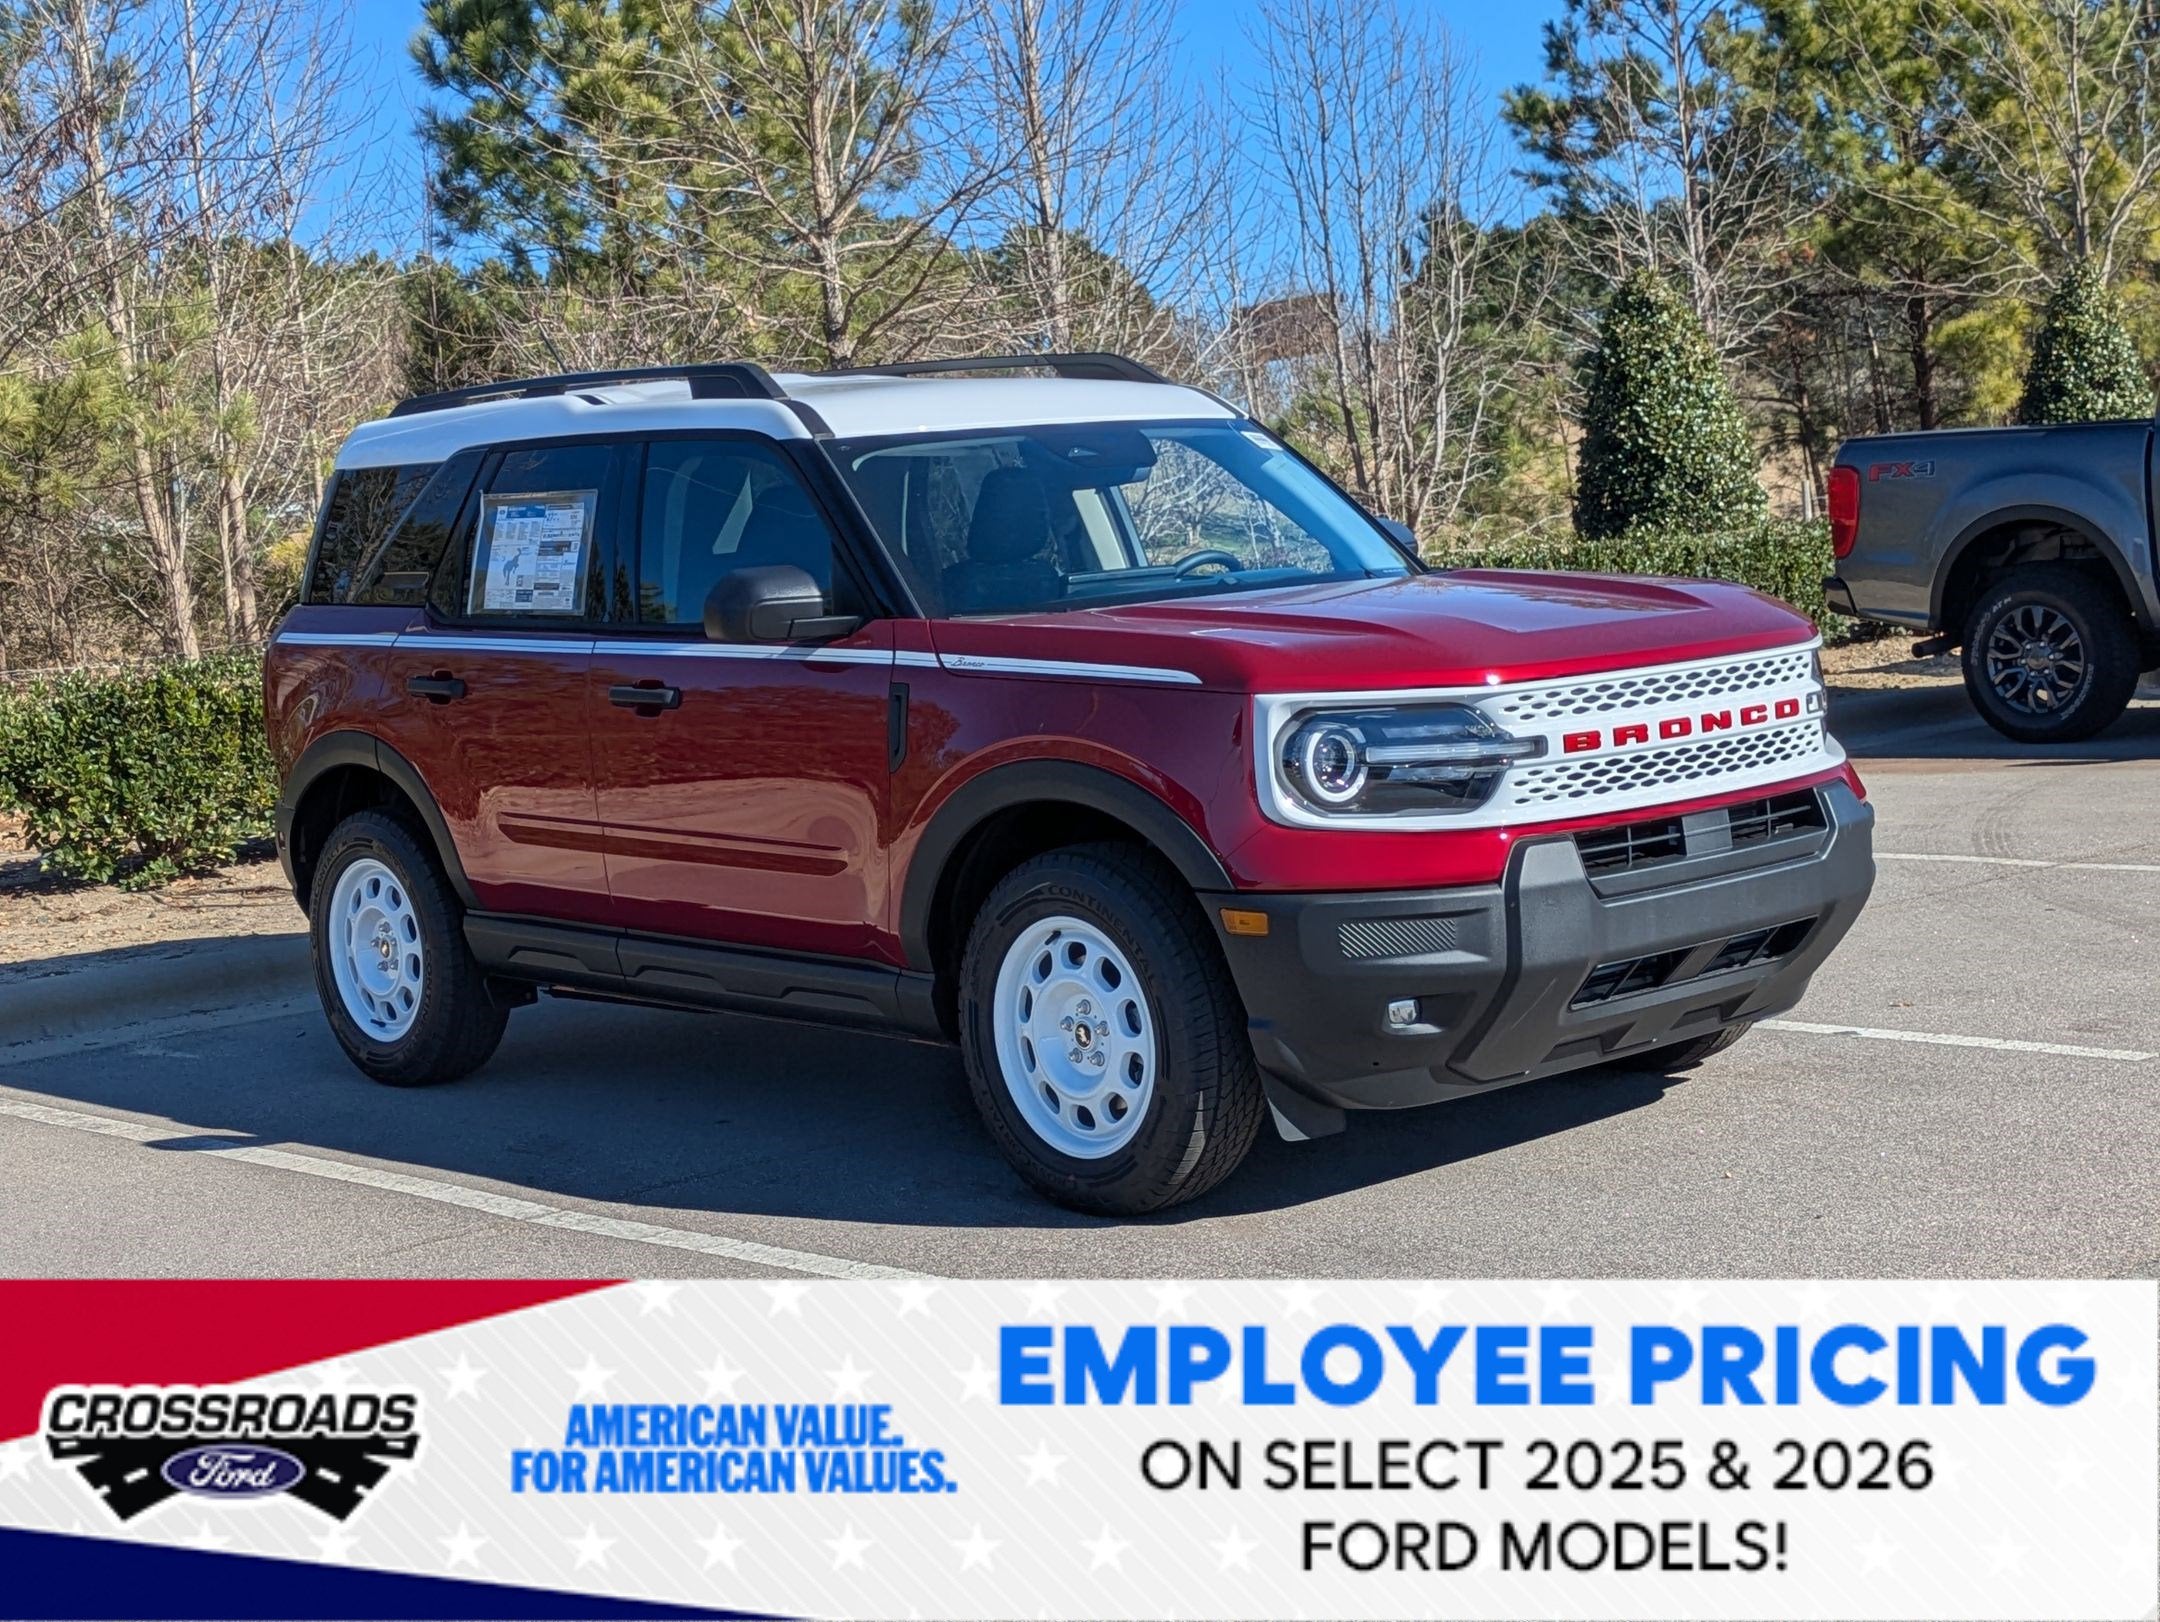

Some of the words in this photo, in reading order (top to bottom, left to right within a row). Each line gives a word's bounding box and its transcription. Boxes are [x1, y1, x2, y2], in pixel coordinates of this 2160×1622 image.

[1867, 460, 1937, 483] FX4
[950, 656, 986, 668] Bronco
[1563, 697, 1800, 754] BRONCO
[1046, 884, 1156, 985] CONTINENTAL
